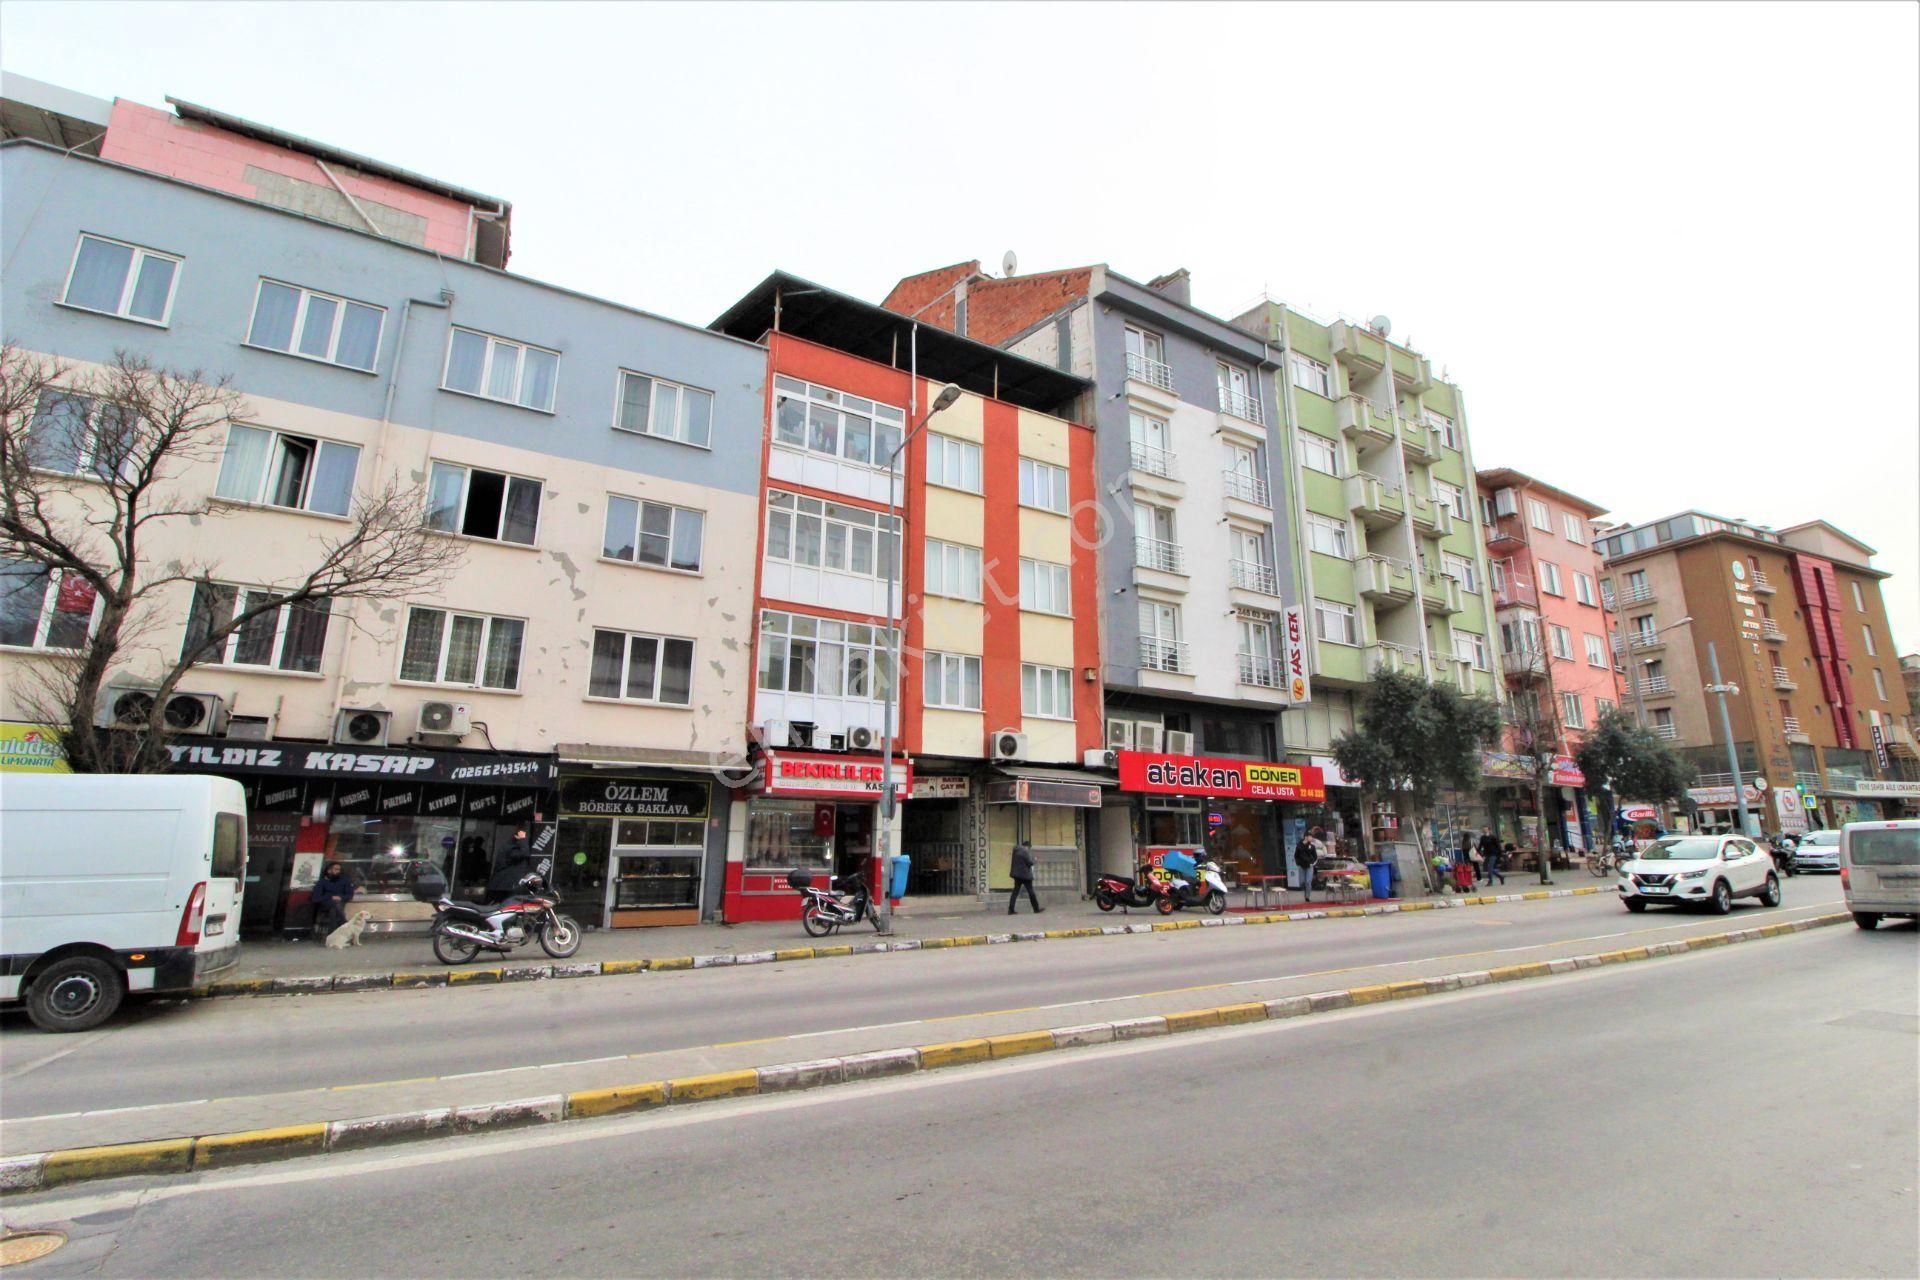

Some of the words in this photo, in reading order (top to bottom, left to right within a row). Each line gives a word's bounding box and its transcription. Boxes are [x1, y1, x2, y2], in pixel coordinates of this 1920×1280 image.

[164, 744, 283, 768] YILDIZ
[304, 751, 435, 775] KASAP
[1147, 760, 1242, 790] atakan
[1250, 767, 1297, 783] DÖNER
[604, 781, 669, 802] ÖZLEM
[865, 782, 899, 792] KASI
[1251, 785, 1275, 795] CELAL
[1276, 787, 1295, 797] USTA
[579, 799, 621, 813] BÖREK
[624, 804, 634, 813] &
[637, 804, 690, 815] BAKLAVA
